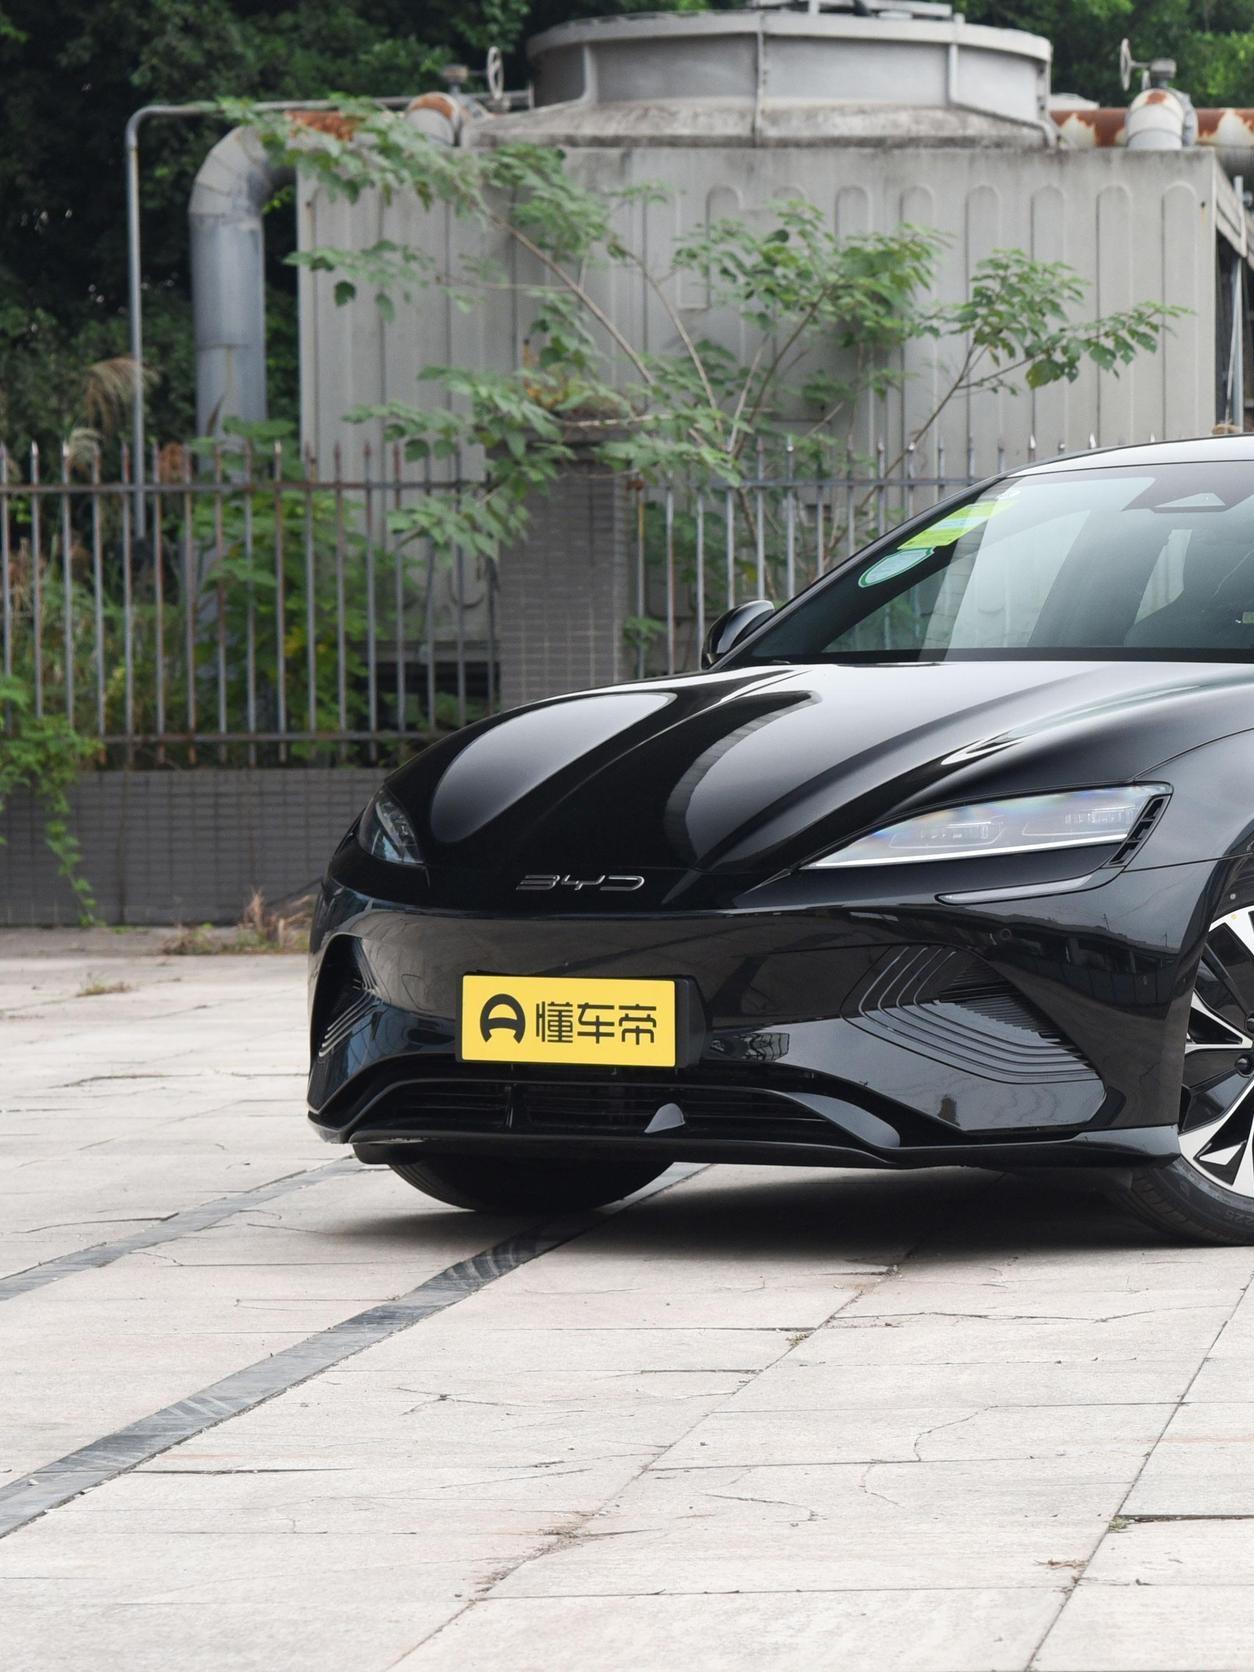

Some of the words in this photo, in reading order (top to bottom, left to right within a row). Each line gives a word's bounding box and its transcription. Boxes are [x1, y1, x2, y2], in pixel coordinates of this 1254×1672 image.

[515, 874, 645, 891] BYD
[536, 1001, 657, 1045] 懂车帝
